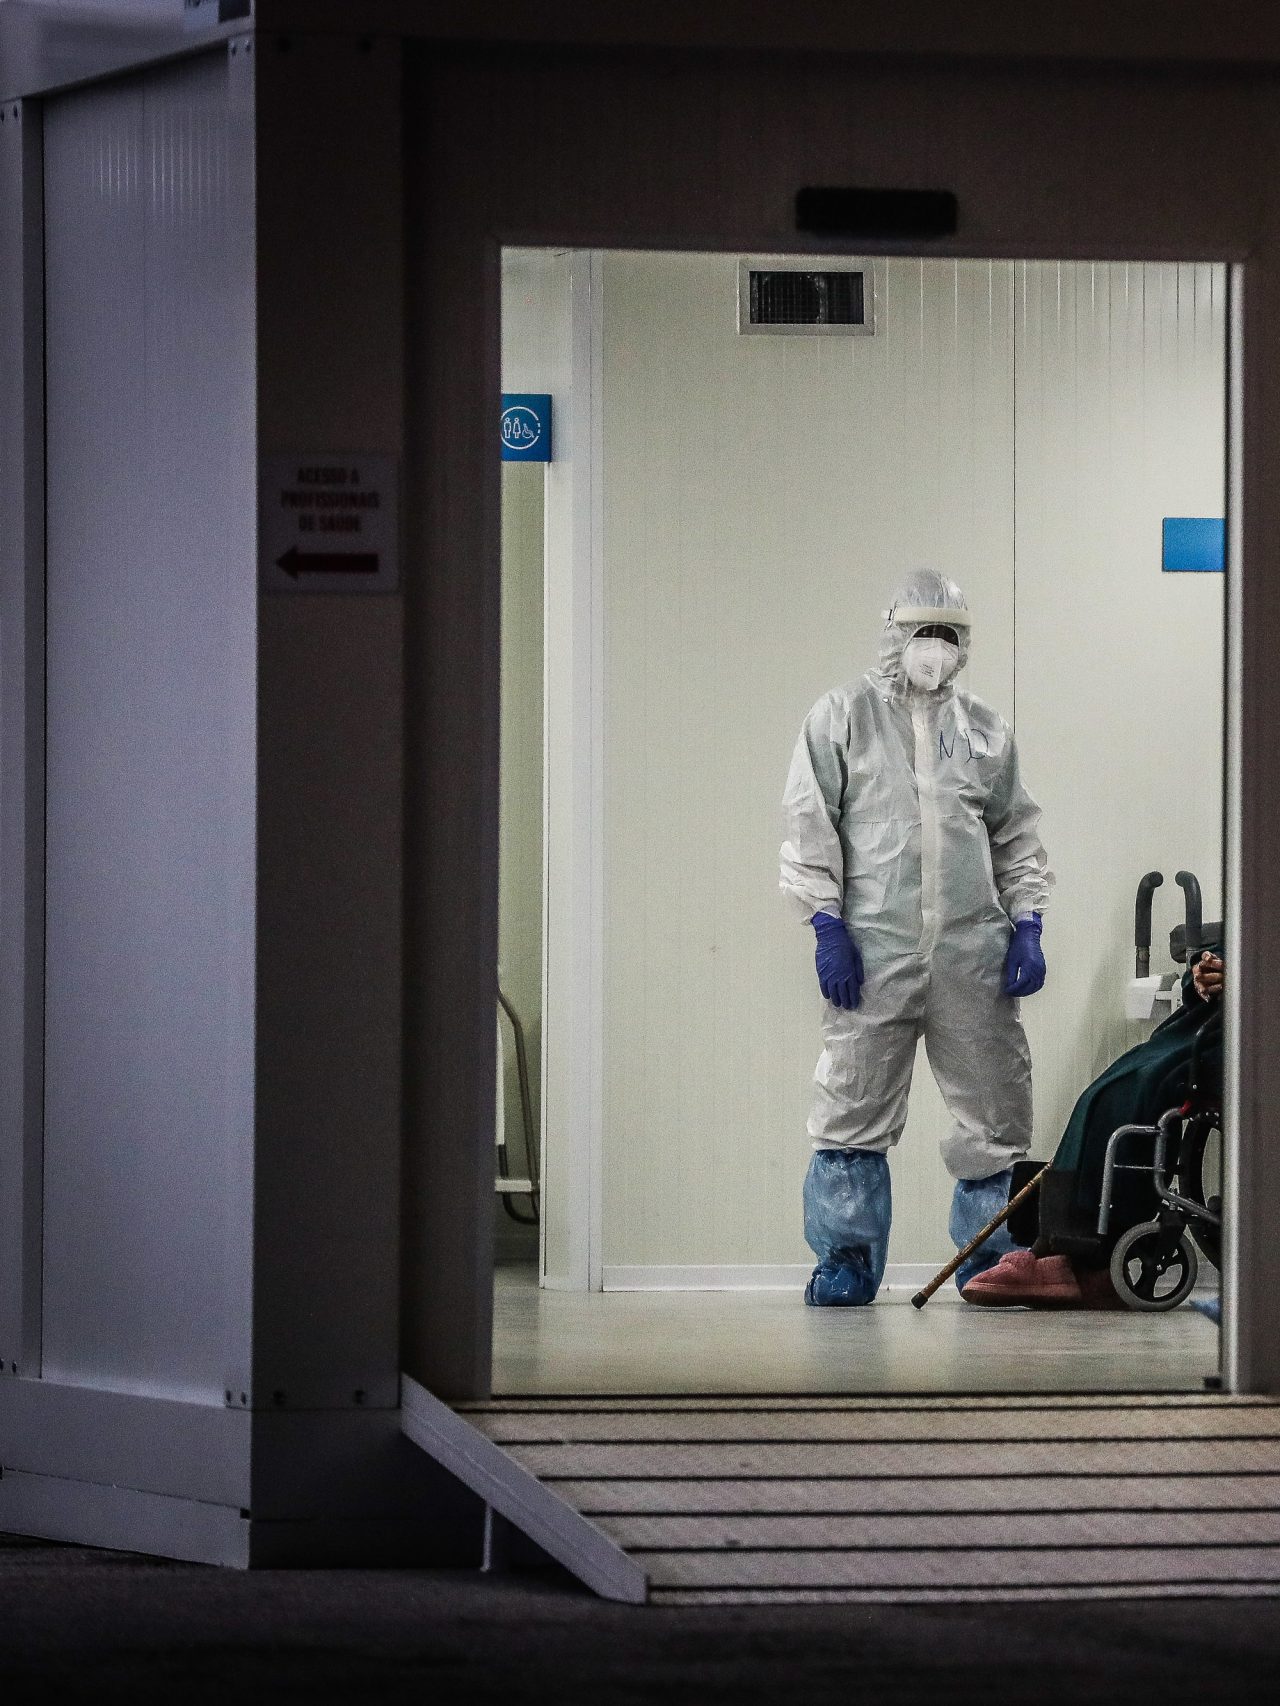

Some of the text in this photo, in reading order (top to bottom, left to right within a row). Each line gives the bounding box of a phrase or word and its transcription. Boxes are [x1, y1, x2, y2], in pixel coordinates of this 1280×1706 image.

[297, 467, 360, 484] ACESSO A
[281, 490, 380, 508] PROFISSIONAIS
[298, 514, 315, 532] DE
